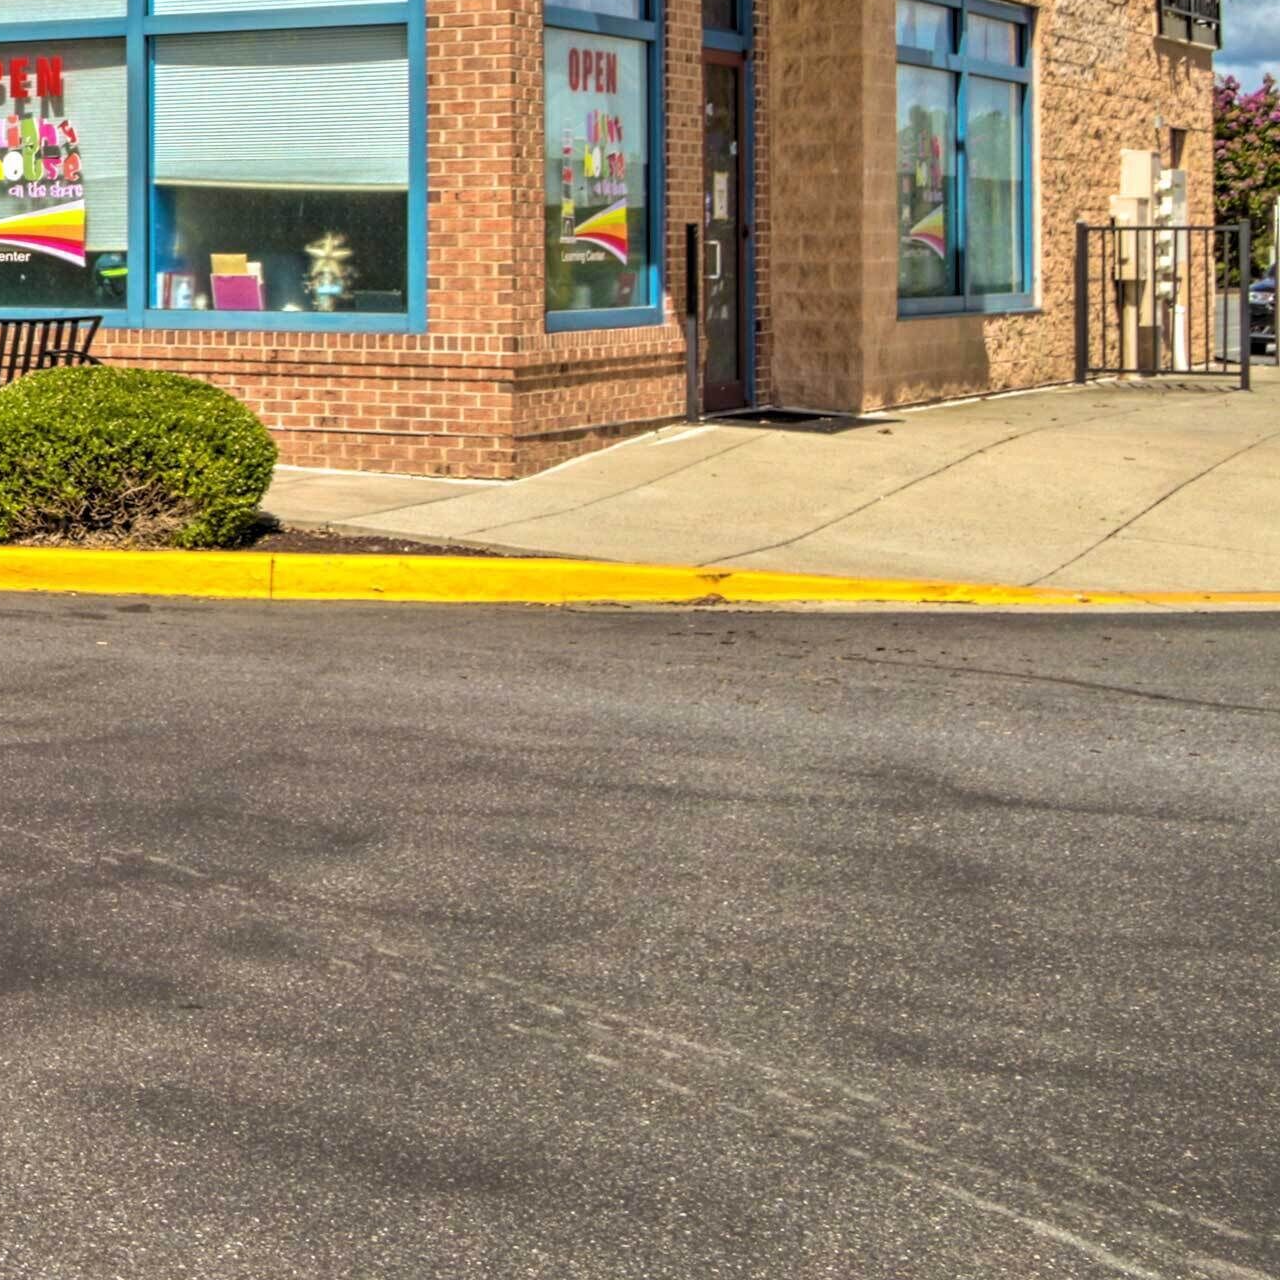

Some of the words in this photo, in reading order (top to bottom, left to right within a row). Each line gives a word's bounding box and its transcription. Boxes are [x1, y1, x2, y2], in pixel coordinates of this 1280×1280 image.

[568, 47, 617, 94] OPEN
[27, 182, 46, 197] the
[49, 182, 83, 198] shore
[561, 250, 585, 264] Learning
[586, 251, 605, 262] Center
